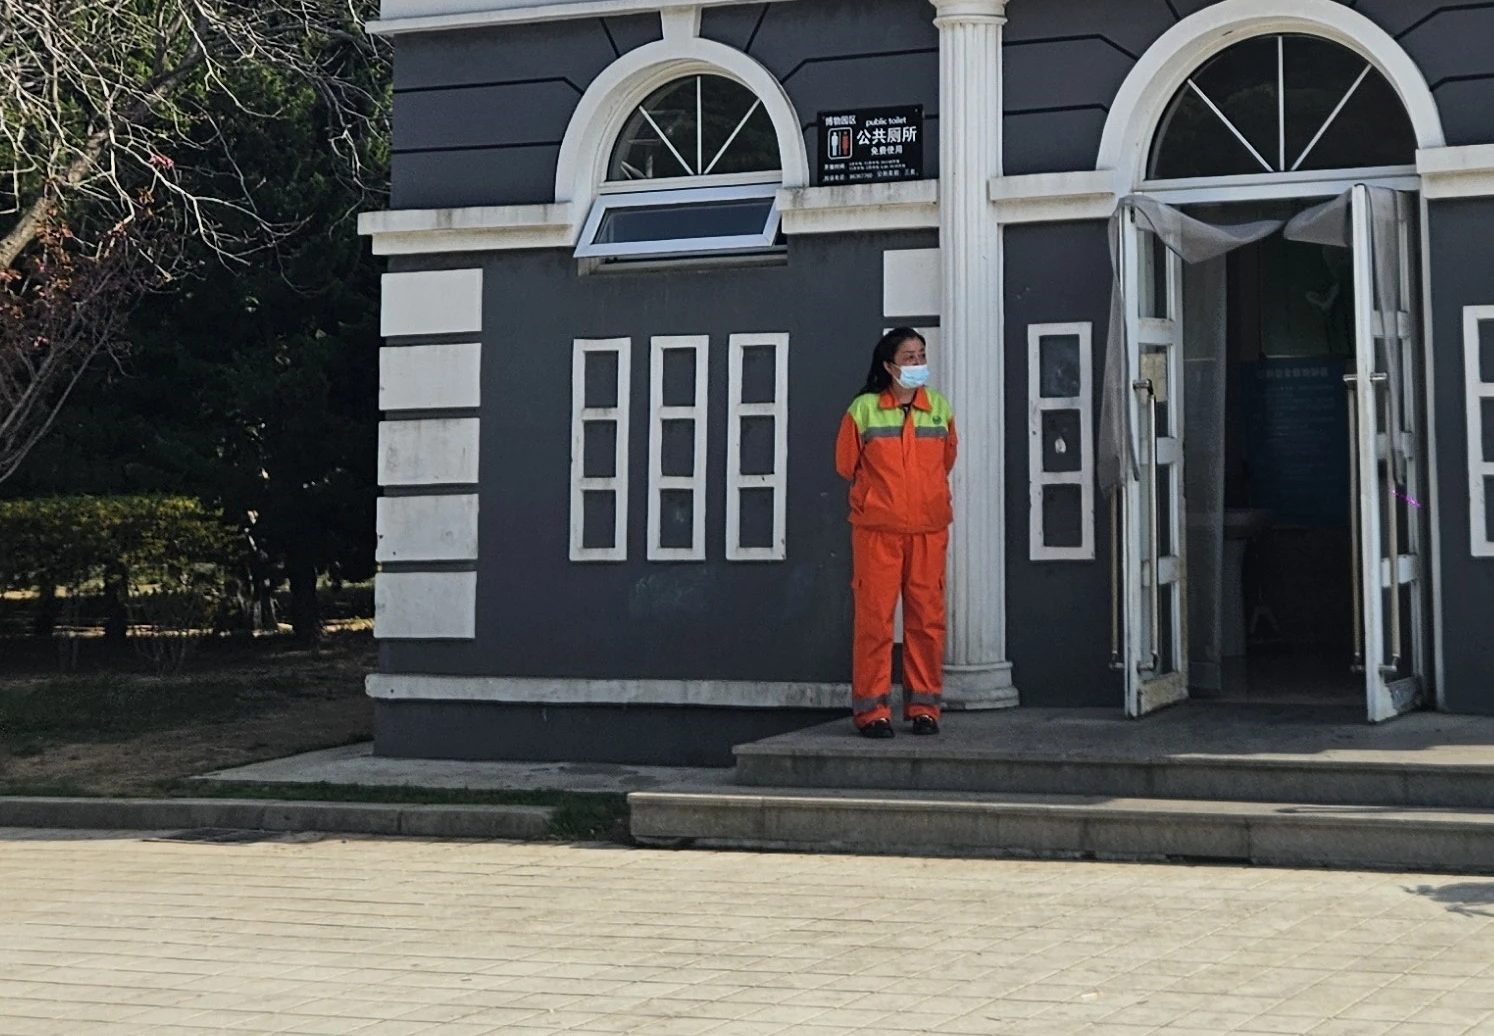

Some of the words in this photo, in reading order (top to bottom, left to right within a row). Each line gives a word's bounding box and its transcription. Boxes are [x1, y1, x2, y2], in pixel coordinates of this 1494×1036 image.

[865, 117, 887, 127] public
[888, 116, 907, 125] toilet
[856, 126, 917, 145] 公共厕所
[870, 145, 903, 156] 免费使用
